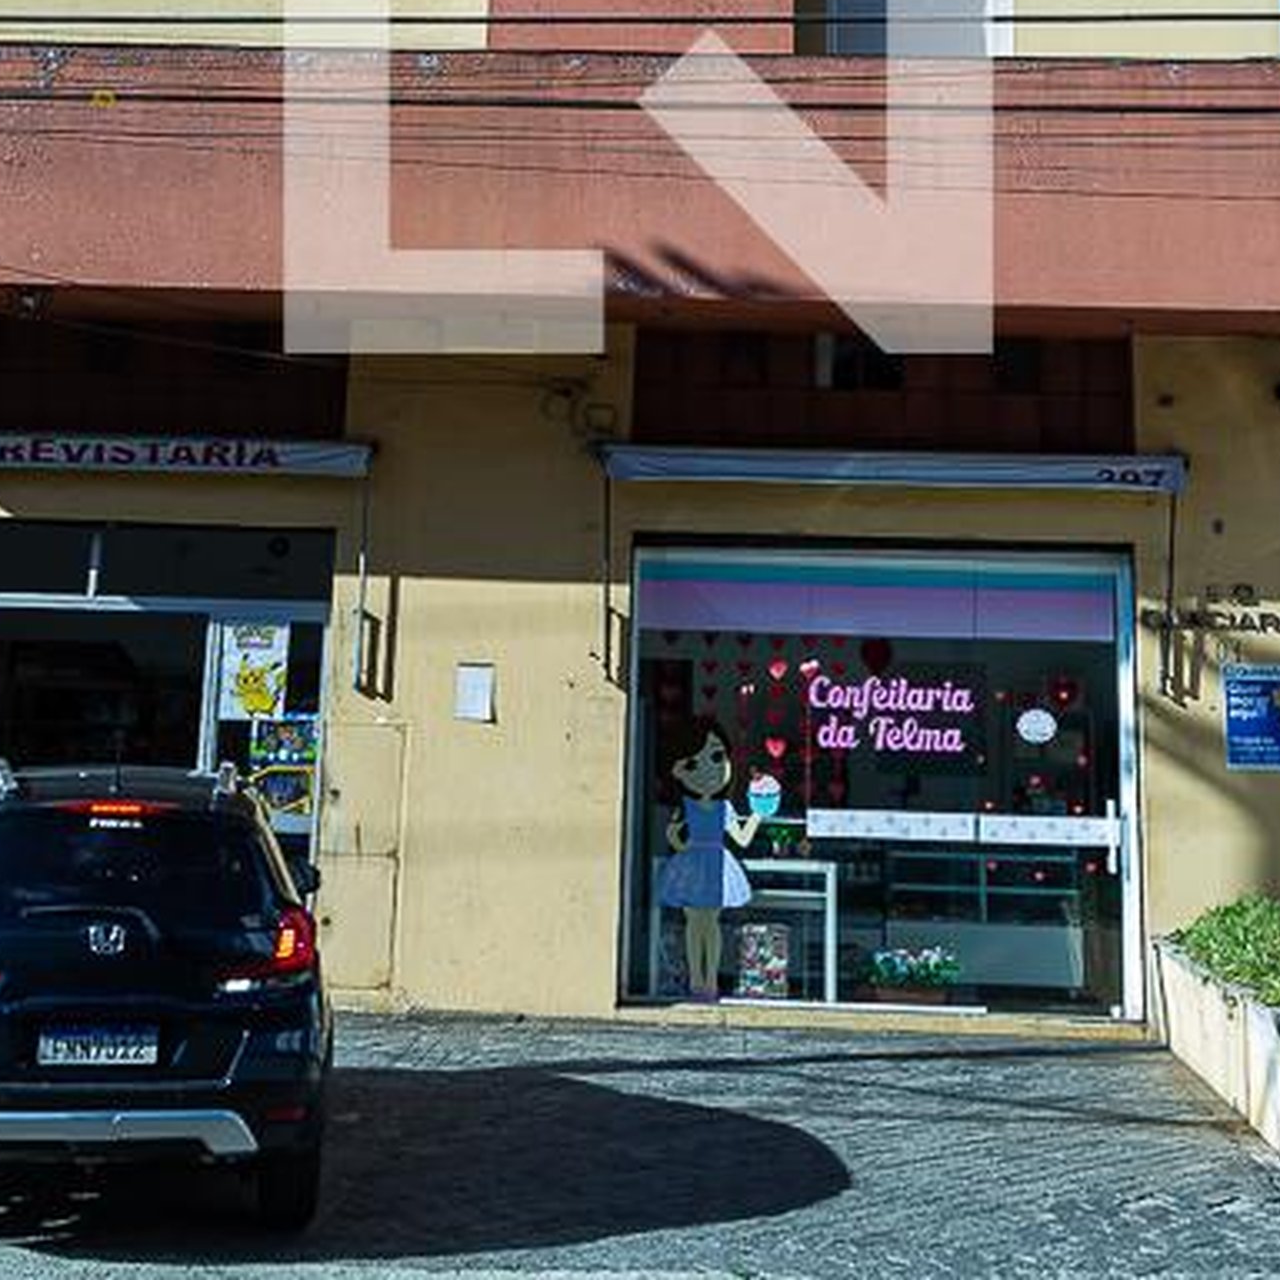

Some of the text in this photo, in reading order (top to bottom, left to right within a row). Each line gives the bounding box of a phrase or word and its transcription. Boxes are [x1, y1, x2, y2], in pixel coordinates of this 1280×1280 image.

[809, 676, 974, 719] Confeitaria
[817, 716, 966, 752] da Telma
